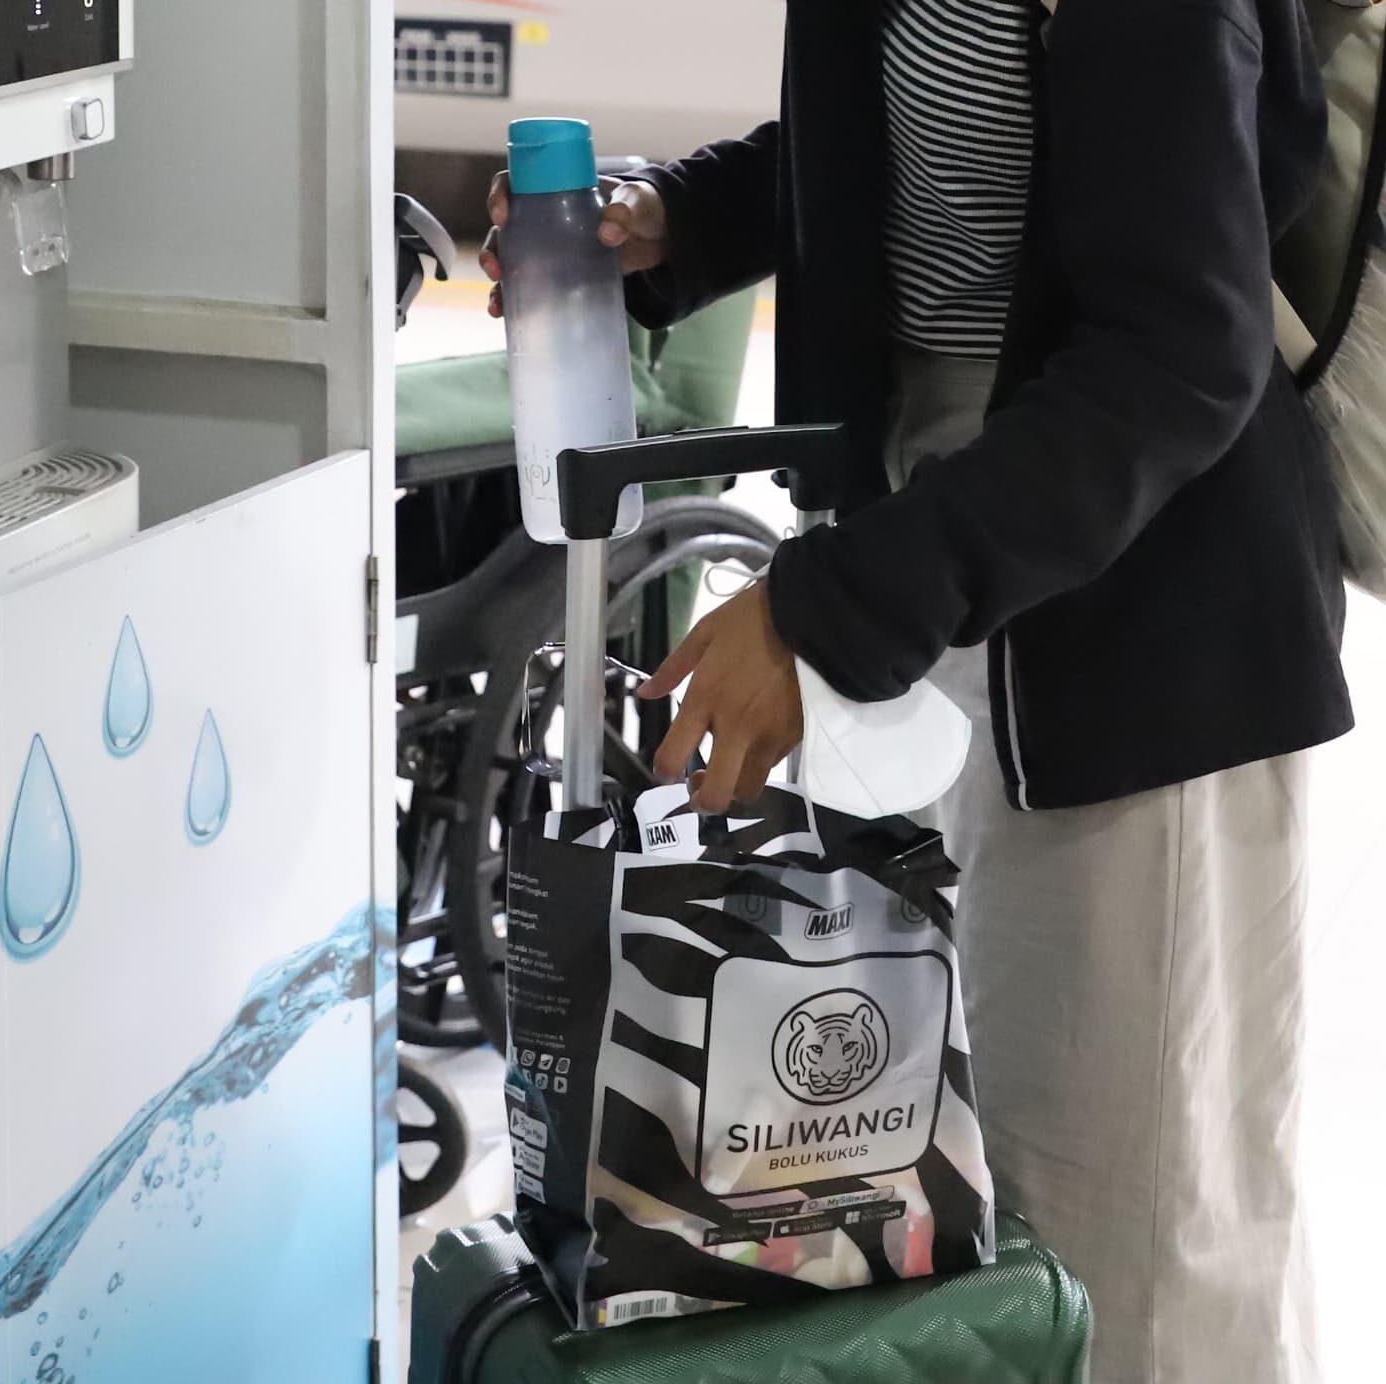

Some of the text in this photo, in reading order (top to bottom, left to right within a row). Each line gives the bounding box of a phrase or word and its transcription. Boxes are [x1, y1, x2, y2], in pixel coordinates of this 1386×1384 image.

[808, 907, 851, 936] MAXI
[726, 1103, 915, 1154] SILIWANGI
[769, 1144, 869, 1171] BOLU KUKUS
